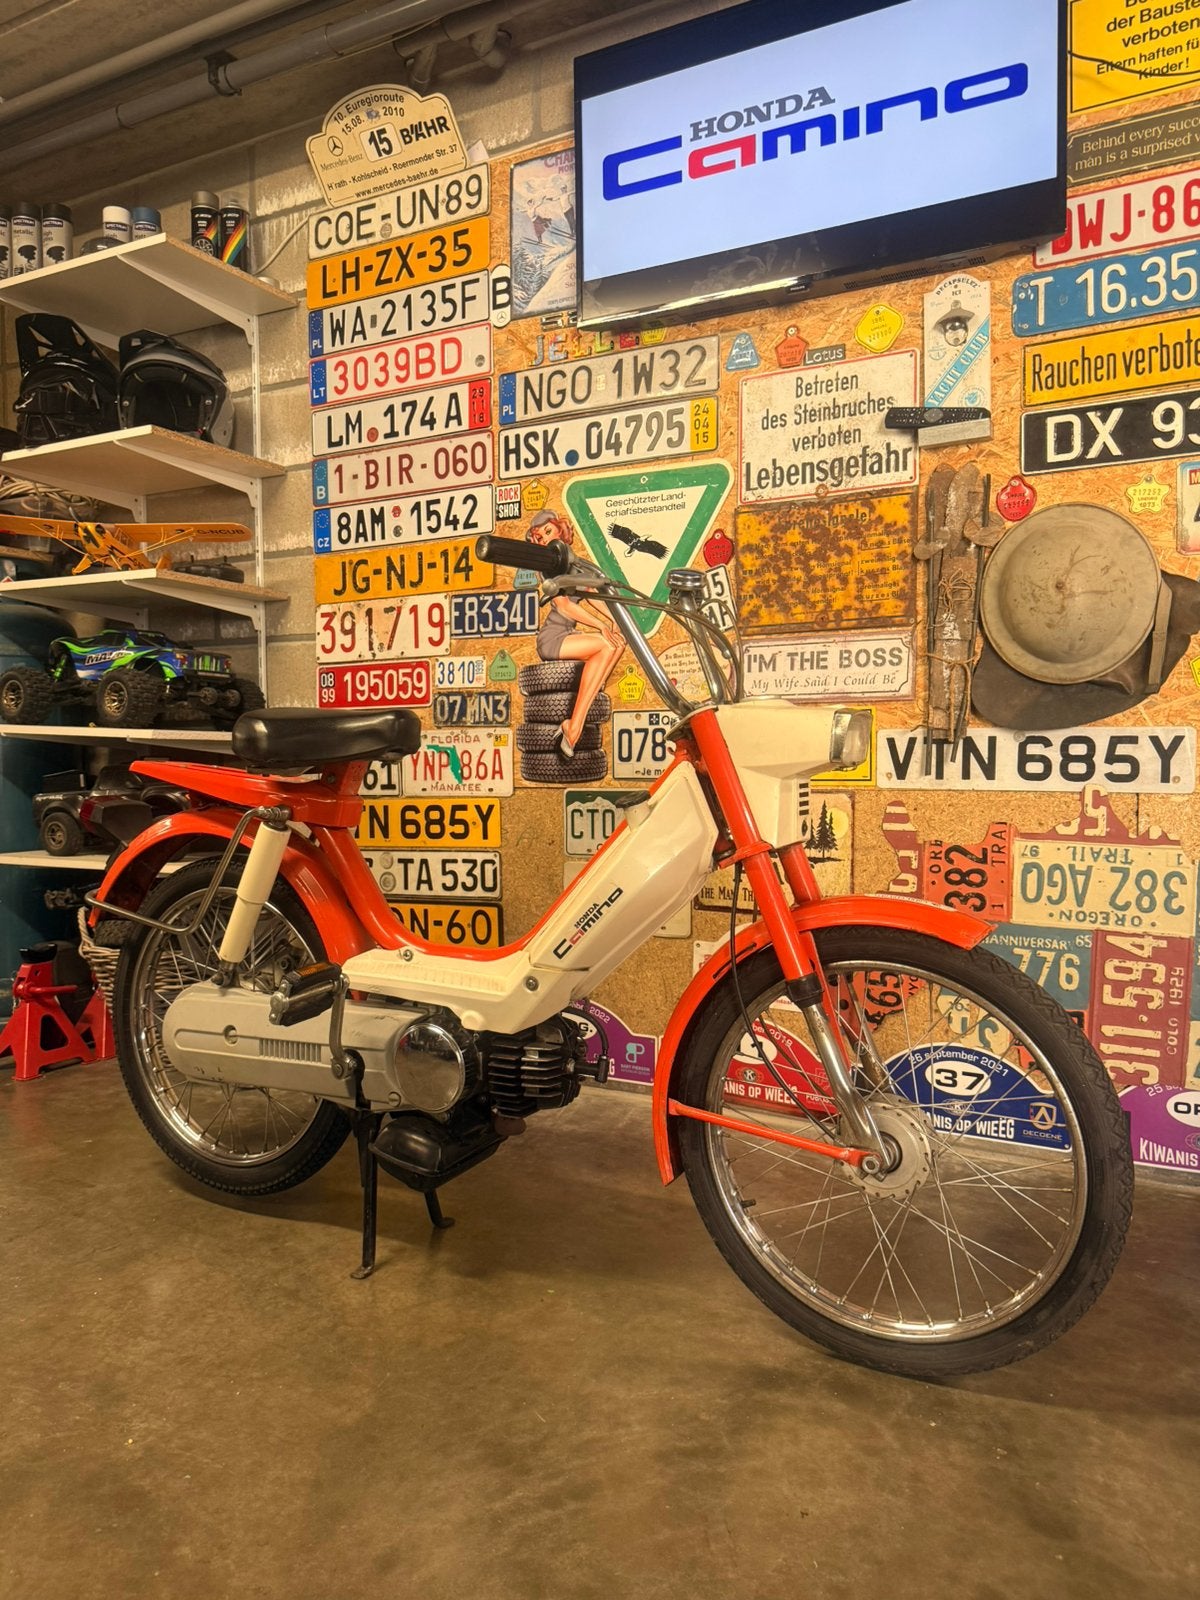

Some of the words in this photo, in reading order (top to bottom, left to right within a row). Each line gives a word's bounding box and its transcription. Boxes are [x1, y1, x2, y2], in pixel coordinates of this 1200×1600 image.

[1106, 15, 1136, 33] der
[1122, 17, 1200, 48] verboten
[1138, 43, 1183, 64] haften
[345, 92, 405, 115] Euregioroute
[689, 85, 837, 143] HONDA
[341, 114, 365, 136] 15.08.
[382, 106, 405, 118] 2010
[368, 127, 394, 158] 15
[1075, 155, 1103, 171] man
[1105, 151, 1117, 164] is
[1119, 149, 1128, 160] a
[1131, 132, 1192, 158] surprised
[1082, 131, 1126, 154] Behind
[1129, 124, 1165, 142] every
[351, 166, 389, 185] Kohlscheid
[392, 151, 435, 172] Roermonder
[435, 147, 449, 159] Str.
[449, 143, 458, 155] 37
[354, 167, 439, 199] www.mercedes-baehr.de
[321, 227, 473, 300] LH-ZX-35
[329, 305, 368, 348] WA
[380, 277, 481, 337] 2135F
[1029, 276, 1054, 326] T
[312, 340, 323, 350] PL
[333, 336, 464, 396] 3039BD
[523, 364, 593, 416] NGO
[611, 344, 708, 400] 1W32
[1031, 345, 1117, 394] Rauchen
[312, 388, 326, 399] LT
[795, 372, 860, 399] Betreten
[502, 405, 515, 416] PL
[693, 402, 710, 417] 24
[693, 416, 710, 430] 04
[761, 408, 788, 431] des
[793, 391, 895, 426] Steinbruches
[327, 409, 363, 449] LM
[503, 427, 560, 472] HSK
[585, 407, 686, 461] 04795
[694, 430, 709, 445] 15
[791, 424, 862, 453] verboten
[1046, 406, 1125, 464] DX
[334, 440, 488, 495] 1-BIR-060
[744, 442, 913, 492] Lebensgefahr
[316, 486, 326, 500] B
[497, 486, 519, 502] ROCK
[605, 493, 660, 508] Geschützter
[660, 490, 687, 502] Land-
[336, 506, 386, 545] 8AM
[410, 493, 479, 536] 1542
[498, 502, 520, 519] SHOX
[605, 502, 687, 518] schaftsbestandteil
[317, 537, 330, 549] CZ
[332, 545, 474, 597] JG-NJ-14
[437, 660, 475, 685] 3810
[746, 653, 777, 674] I'M
[786, 650, 829, 672] THE
[838, 646, 903, 670] BOSS
[320, 672, 336, 688] 08
[343, 667, 428, 703] 195059
[751, 678, 770, 695] My
[774, 676, 799, 694] Wife
[803, 675, 829, 688] Said
[843, 673, 877, 686] Could
[882, 673, 897, 686] Be
[320, 688, 336, 704] 99
[430, 734, 481, 745] FLORIDA
[617, 727, 667, 763] 078
[460, 748, 504, 781] 86A
[886, 735, 997, 781] VTN
[1016, 734, 1186, 784] 685Y
[430, 782, 483, 793] MANATEE
[400, 804, 495, 841] 685Y
[1021, 845, 1040, 858] 97
[1065, 846, 1134, 865] TRAIL
[397, 857, 434, 892] TA
[441, 858, 498, 893] 530
[943, 844, 989, 913] 382
[1108, 866, 1188, 916] 382
[573, 902, 600, 929] HONDA
[1059, 910, 1143, 928] OREGON
[589, 1005, 611, 1024] 2022
[723, 1081, 746, 1097] ANIS
[748, 1084, 761, 1099] OP
[934, 1068, 985, 1092] 37
[1145, 1083, 1164, 1097] 25
[922, 1110, 952, 1130] ANIS
[1139, 1137, 1199, 1168] KIWANIS
